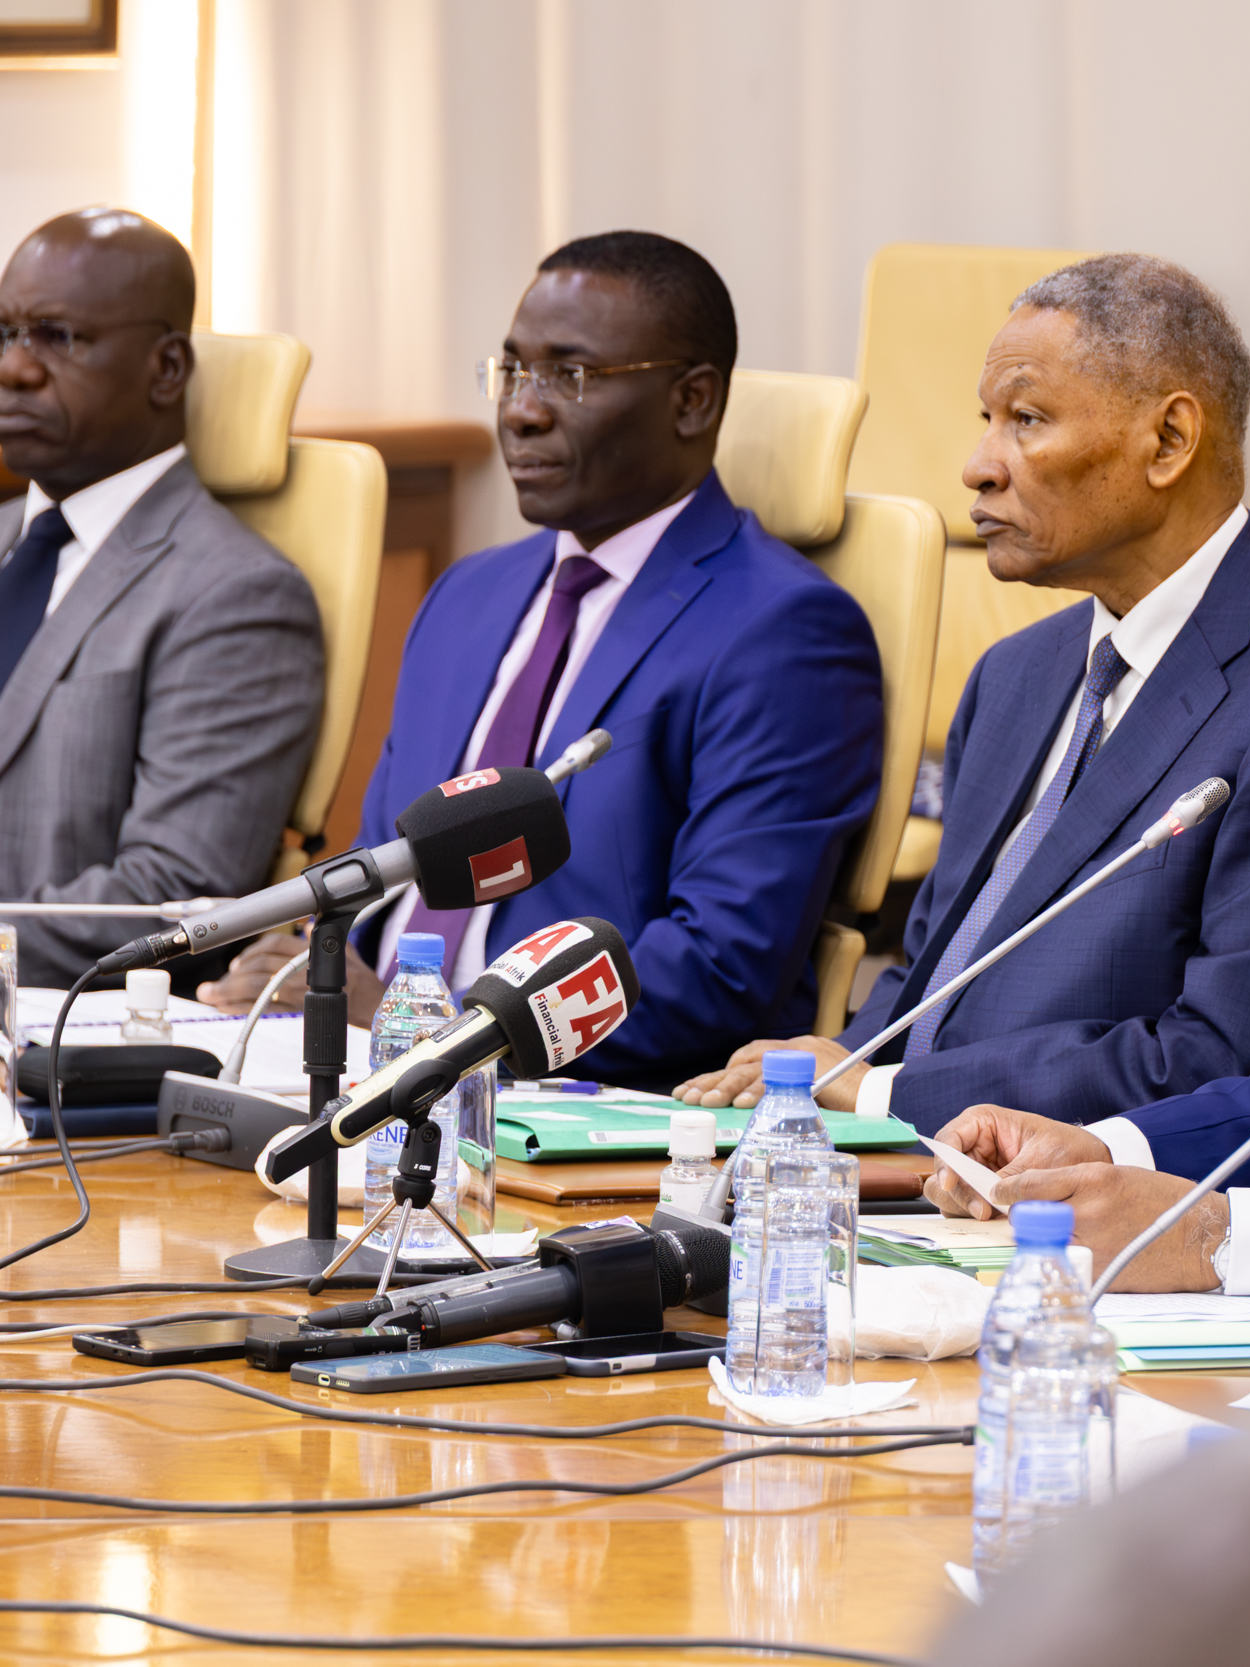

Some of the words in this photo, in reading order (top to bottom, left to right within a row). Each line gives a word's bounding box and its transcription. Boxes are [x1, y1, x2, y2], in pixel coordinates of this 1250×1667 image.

[479, 860, 525, 889] 1
[513, 922, 580, 966] A
[505, 965, 526, 982] Afrik
[534, 993, 562, 1045] Financial
[556, 954, 625, 1057] FA
[192, 1095, 236, 1118] BOSCH
